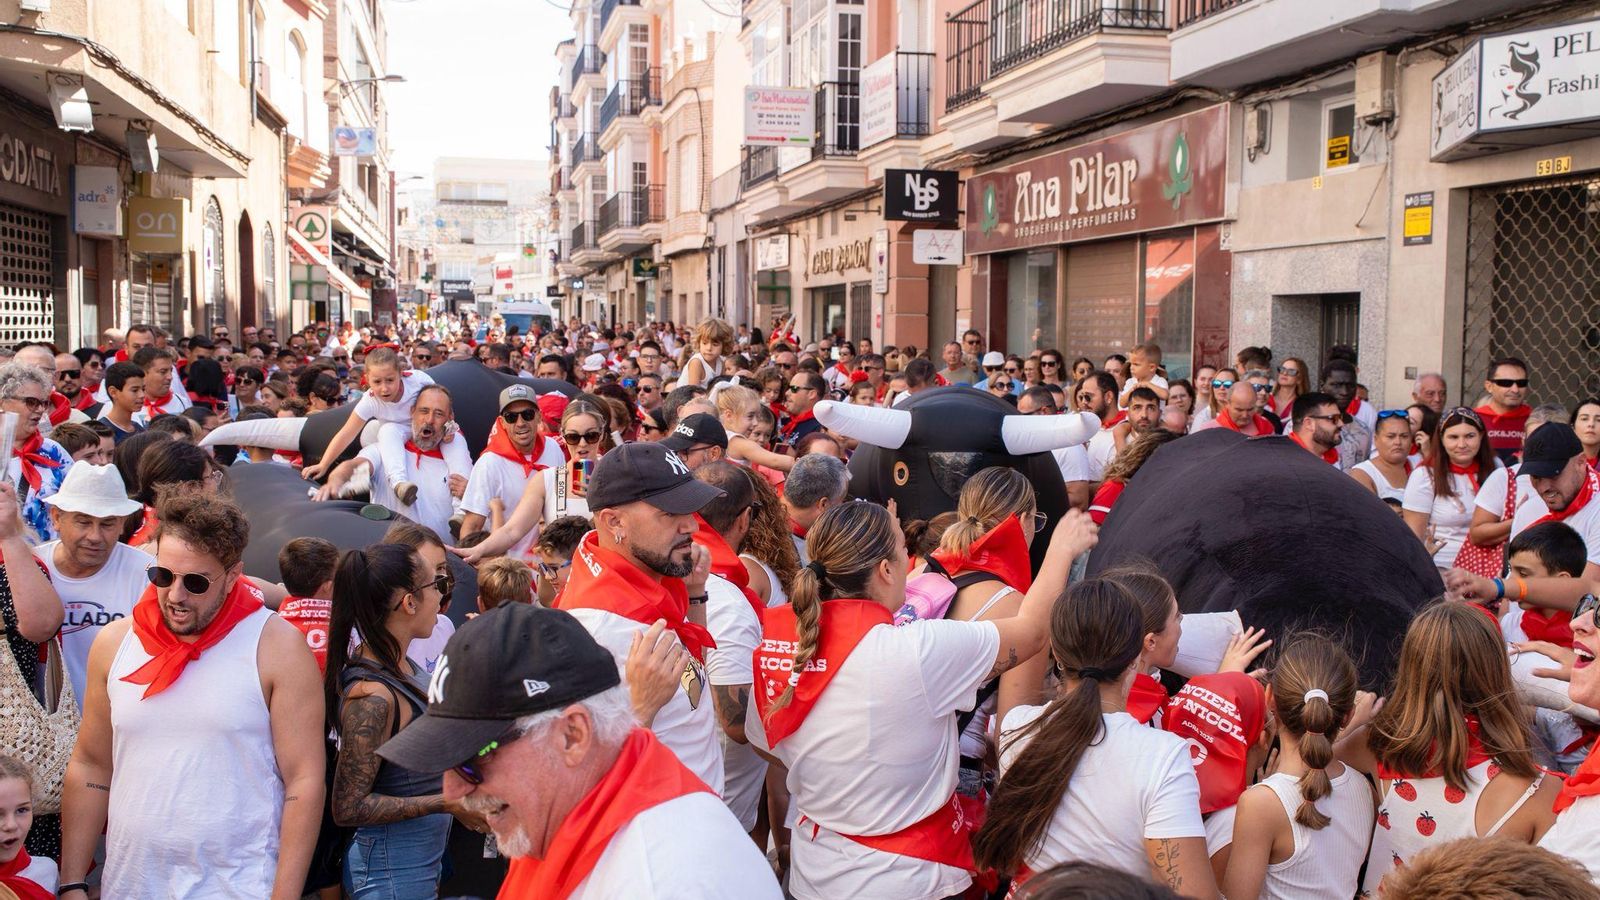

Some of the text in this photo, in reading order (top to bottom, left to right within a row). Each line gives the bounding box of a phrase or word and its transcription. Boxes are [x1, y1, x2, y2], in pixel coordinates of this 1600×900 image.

[1553, 31, 1600, 58] PEL
[1548, 73, 1600, 95] Fashi
[1538, 157, 1570, 175] 59 BJ
[78, 190, 109, 204] adra
[904, 173, 939, 211] NBS
[1014, 152, 1137, 224] Ana Pilar
[137, 212, 177, 231] on
[760, 657, 827, 672] ICOAS
[1183, 698, 1247, 745] NICOL
